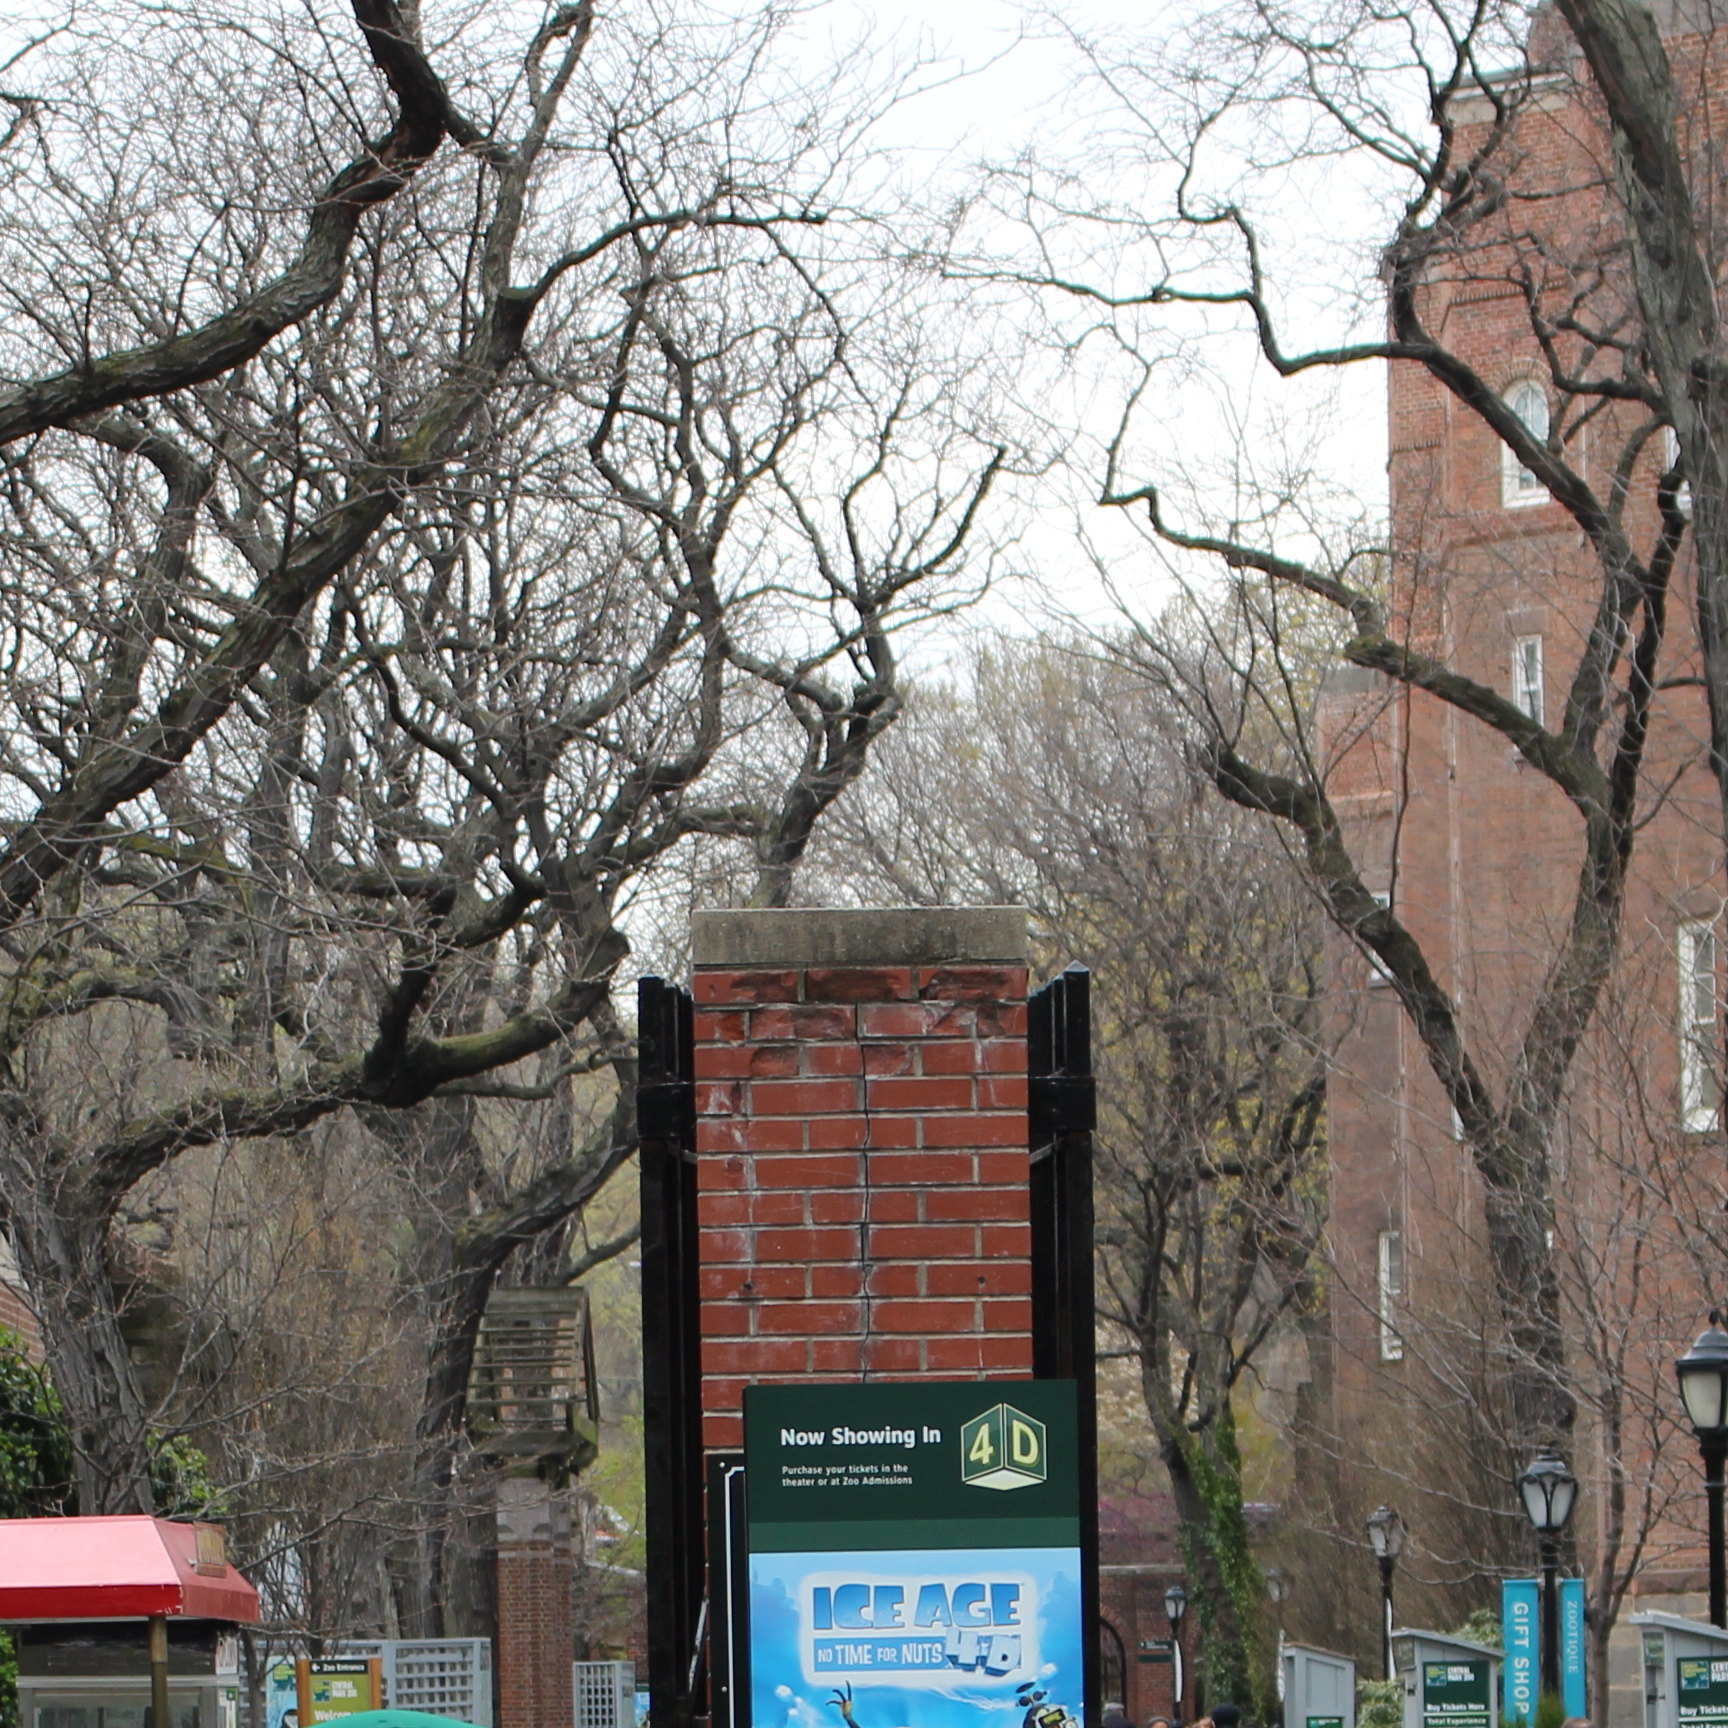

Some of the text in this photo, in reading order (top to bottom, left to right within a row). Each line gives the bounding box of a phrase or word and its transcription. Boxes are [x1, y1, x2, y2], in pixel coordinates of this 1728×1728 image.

[780, 1428, 825, 1447] Now
[831, 1426, 916, 1448] Showing
[922, 1426, 941, 1444] In
[781, 1463, 909, 1477] Purchase your tickets in the
[781, 1475, 913, 1488] theater or at Zoo Admissions
[812, 1582, 1022, 1631] ICE AGE
[1567, 1600, 1580, 1674] ZOOTIQUE
[817, 1649, 833, 1663] NO
[834, 1643, 873, 1665] TIME
[877, 1647, 897, 1663] FOR
[901, 1642, 944, 1665] NUTS
[1514, 1601, 1531, 1715] GIFT SHOP
[1680, 1705, 1698, 1717] Buy
